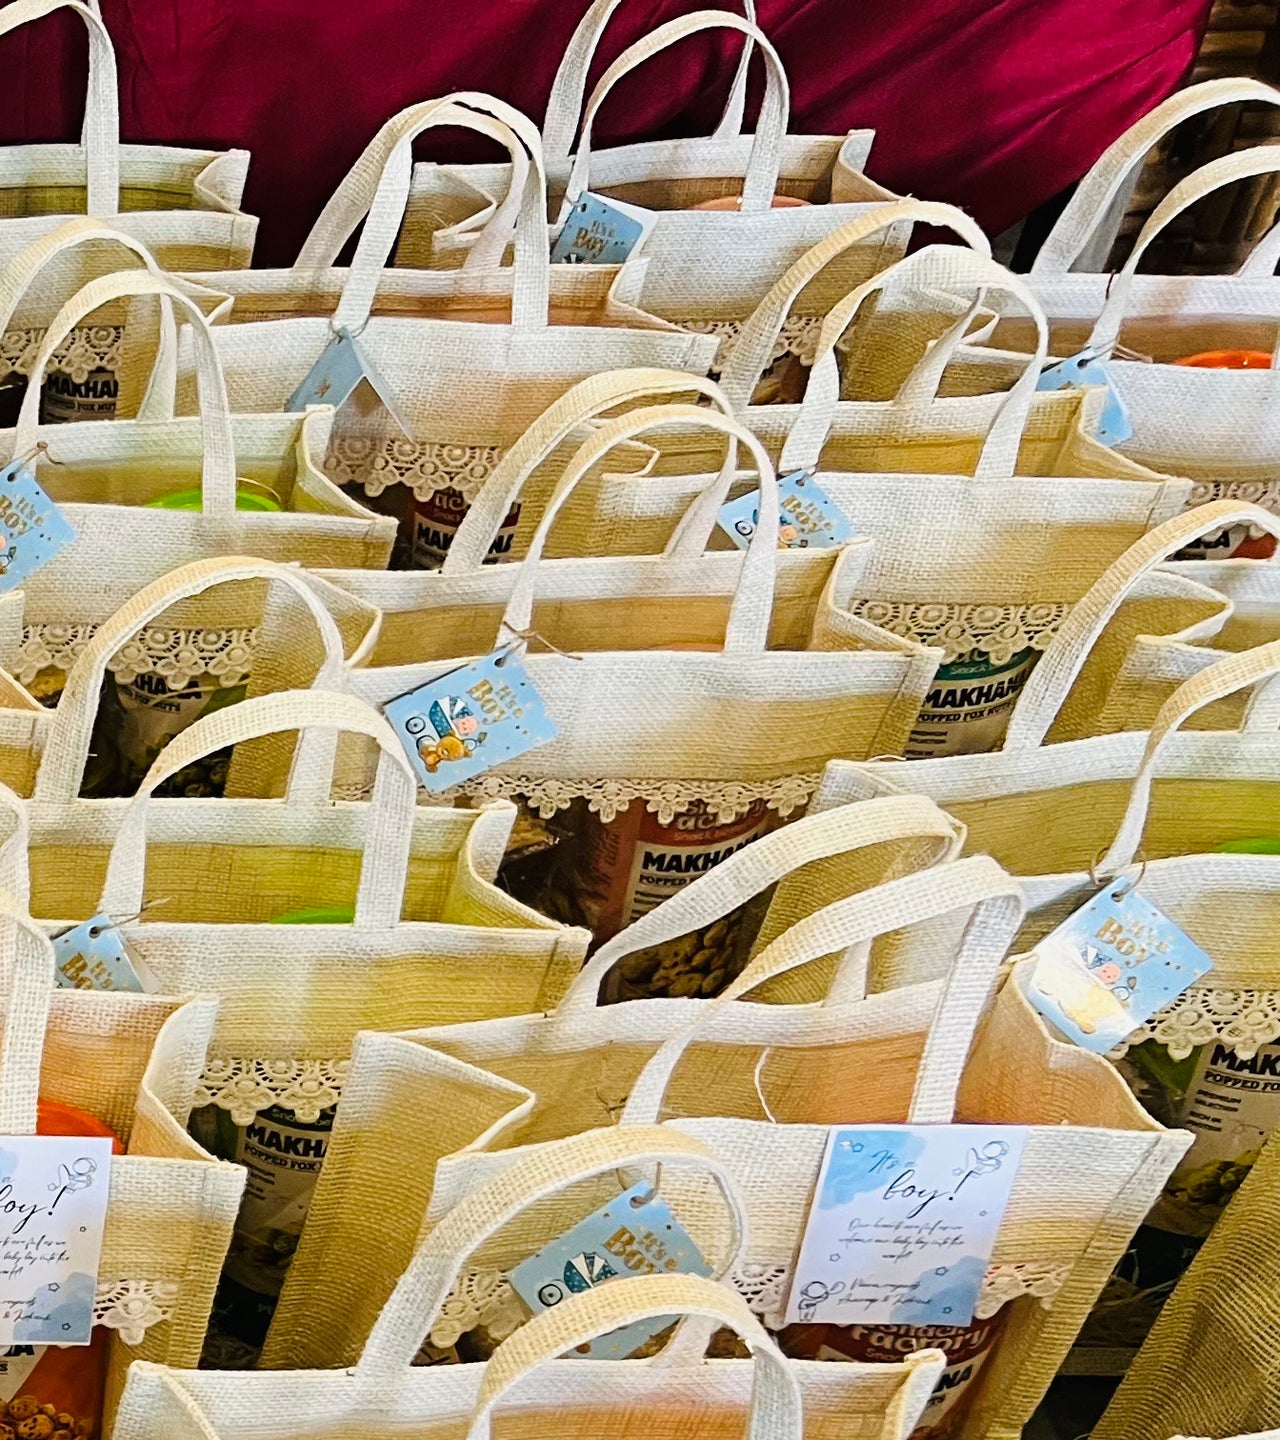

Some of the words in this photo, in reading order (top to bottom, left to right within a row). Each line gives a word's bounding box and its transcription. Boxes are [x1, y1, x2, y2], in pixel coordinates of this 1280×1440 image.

[61, 951, 95, 990] Bo
[1261, 1082, 1280, 1093] FO
[245, 1123, 330, 1159] MAKH
[882, 1169, 973, 1219] boy!
[601, 1224, 656, 1275] Boy
